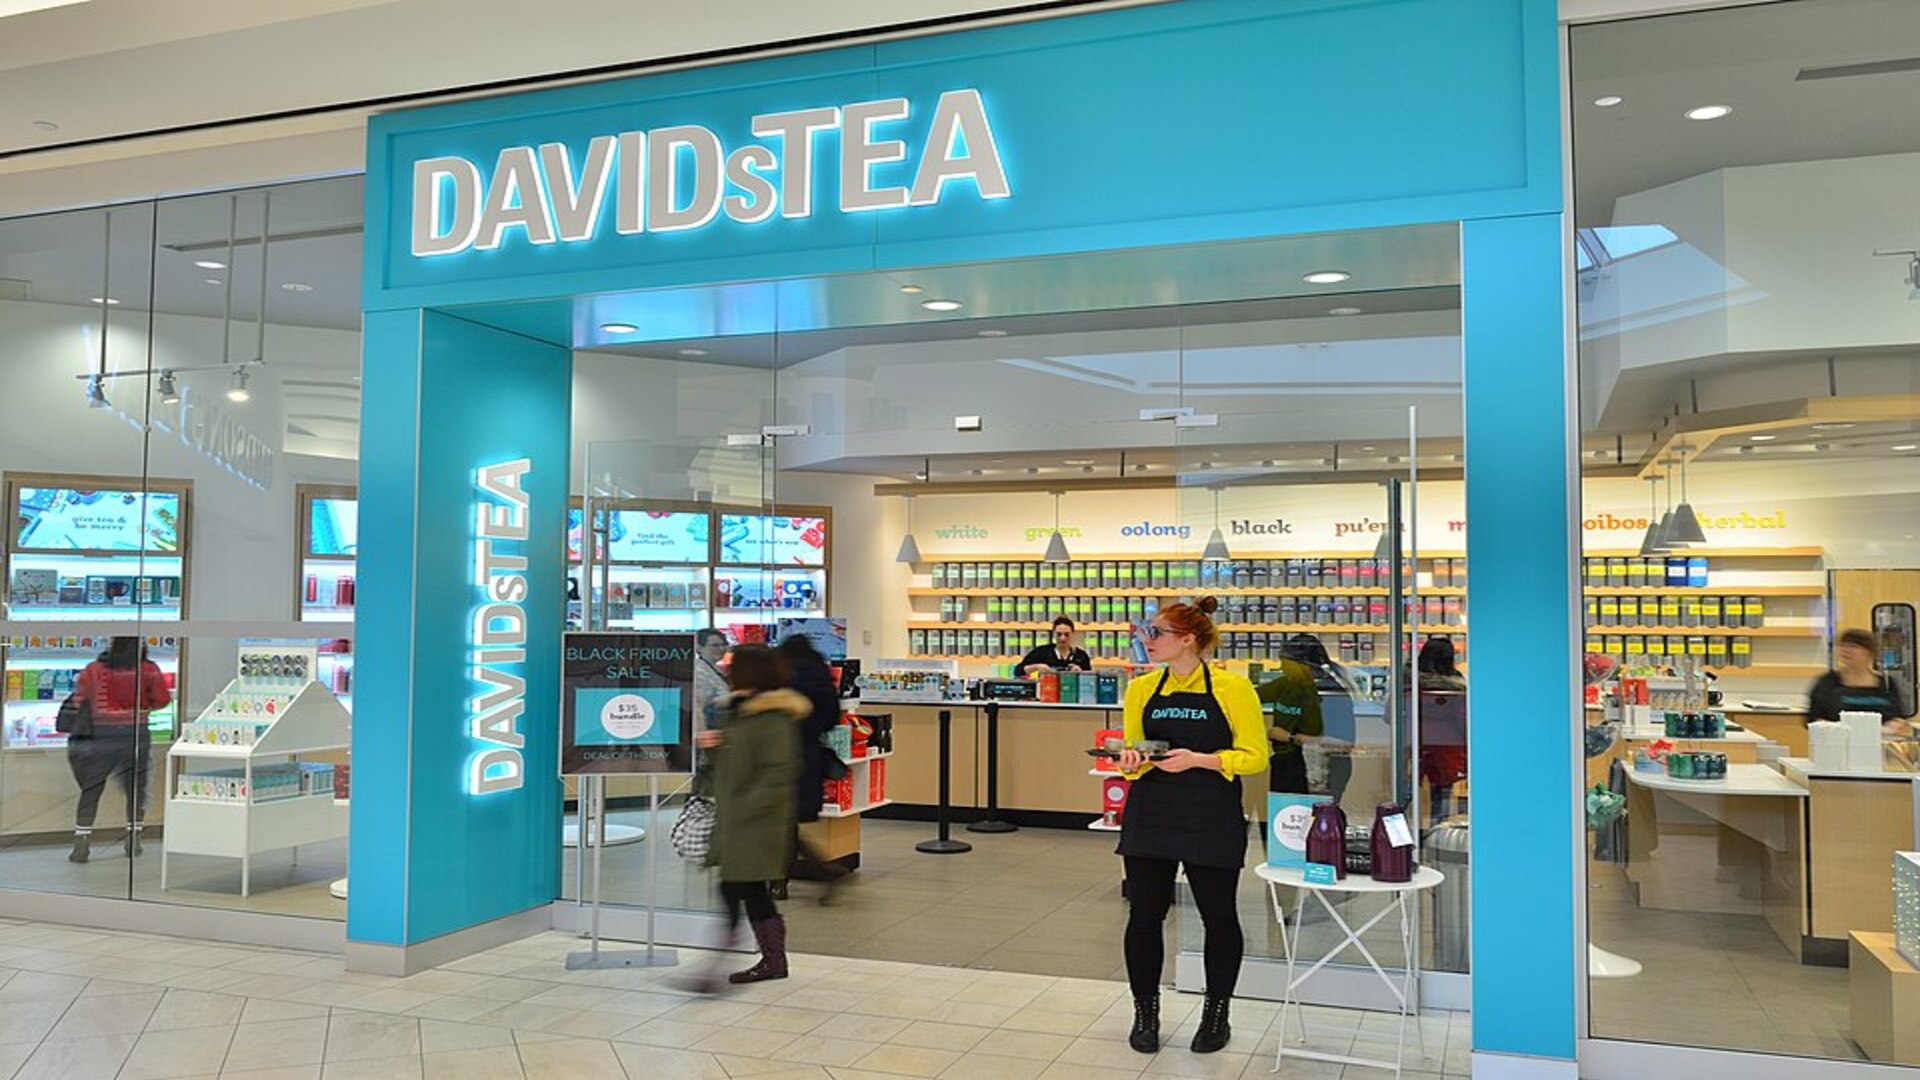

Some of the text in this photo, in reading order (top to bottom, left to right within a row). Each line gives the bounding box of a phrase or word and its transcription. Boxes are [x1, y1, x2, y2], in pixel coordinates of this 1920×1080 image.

[934, 524, 989, 539] white
[1120, 521, 1190, 538] oolong
[1231, 519, 1292, 535] black
[1334, 517, 1406, 537] pu'er
[566, 647, 692, 661] BLACK FRIDAY
[606, 665, 652, 679] SALE
[619, 704, 639, 712] $35
[609, 712, 645, 720] bundle
